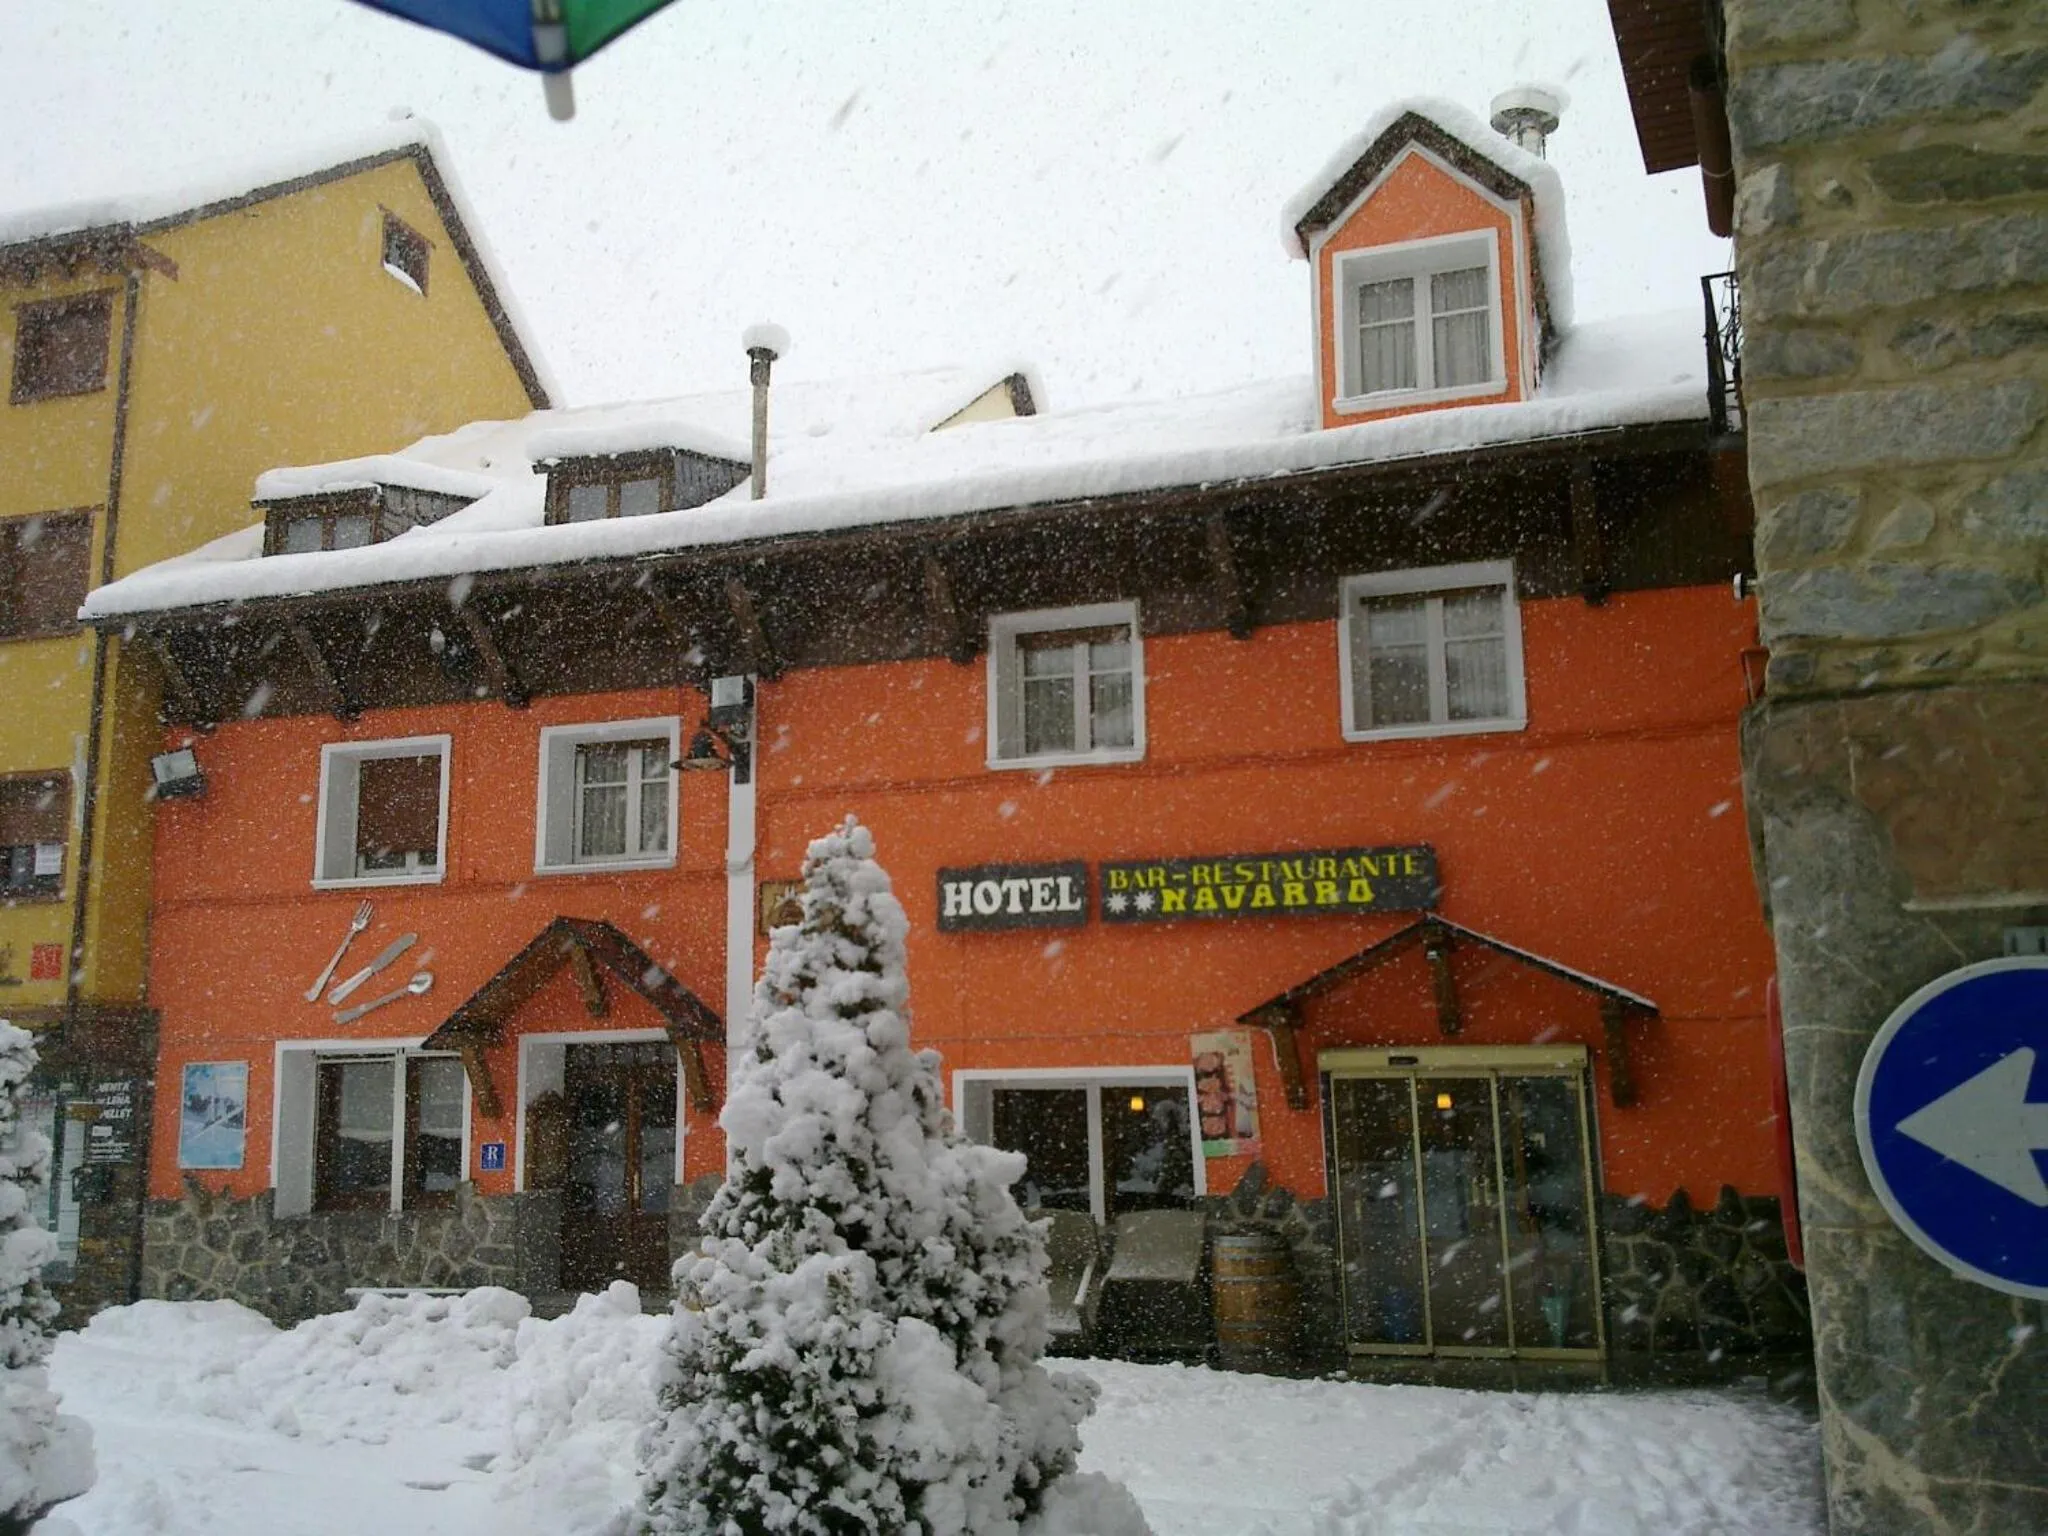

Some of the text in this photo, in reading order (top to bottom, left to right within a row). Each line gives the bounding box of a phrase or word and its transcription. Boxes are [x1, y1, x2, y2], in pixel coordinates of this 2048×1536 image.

[1108, 853, 1425, 891] BAR-RESTAURANTE
[943, 876, 1082, 917] HOTEL
[1161, 877, 1376, 913] NAVARRO
[487, 1145, 498, 1161] R
